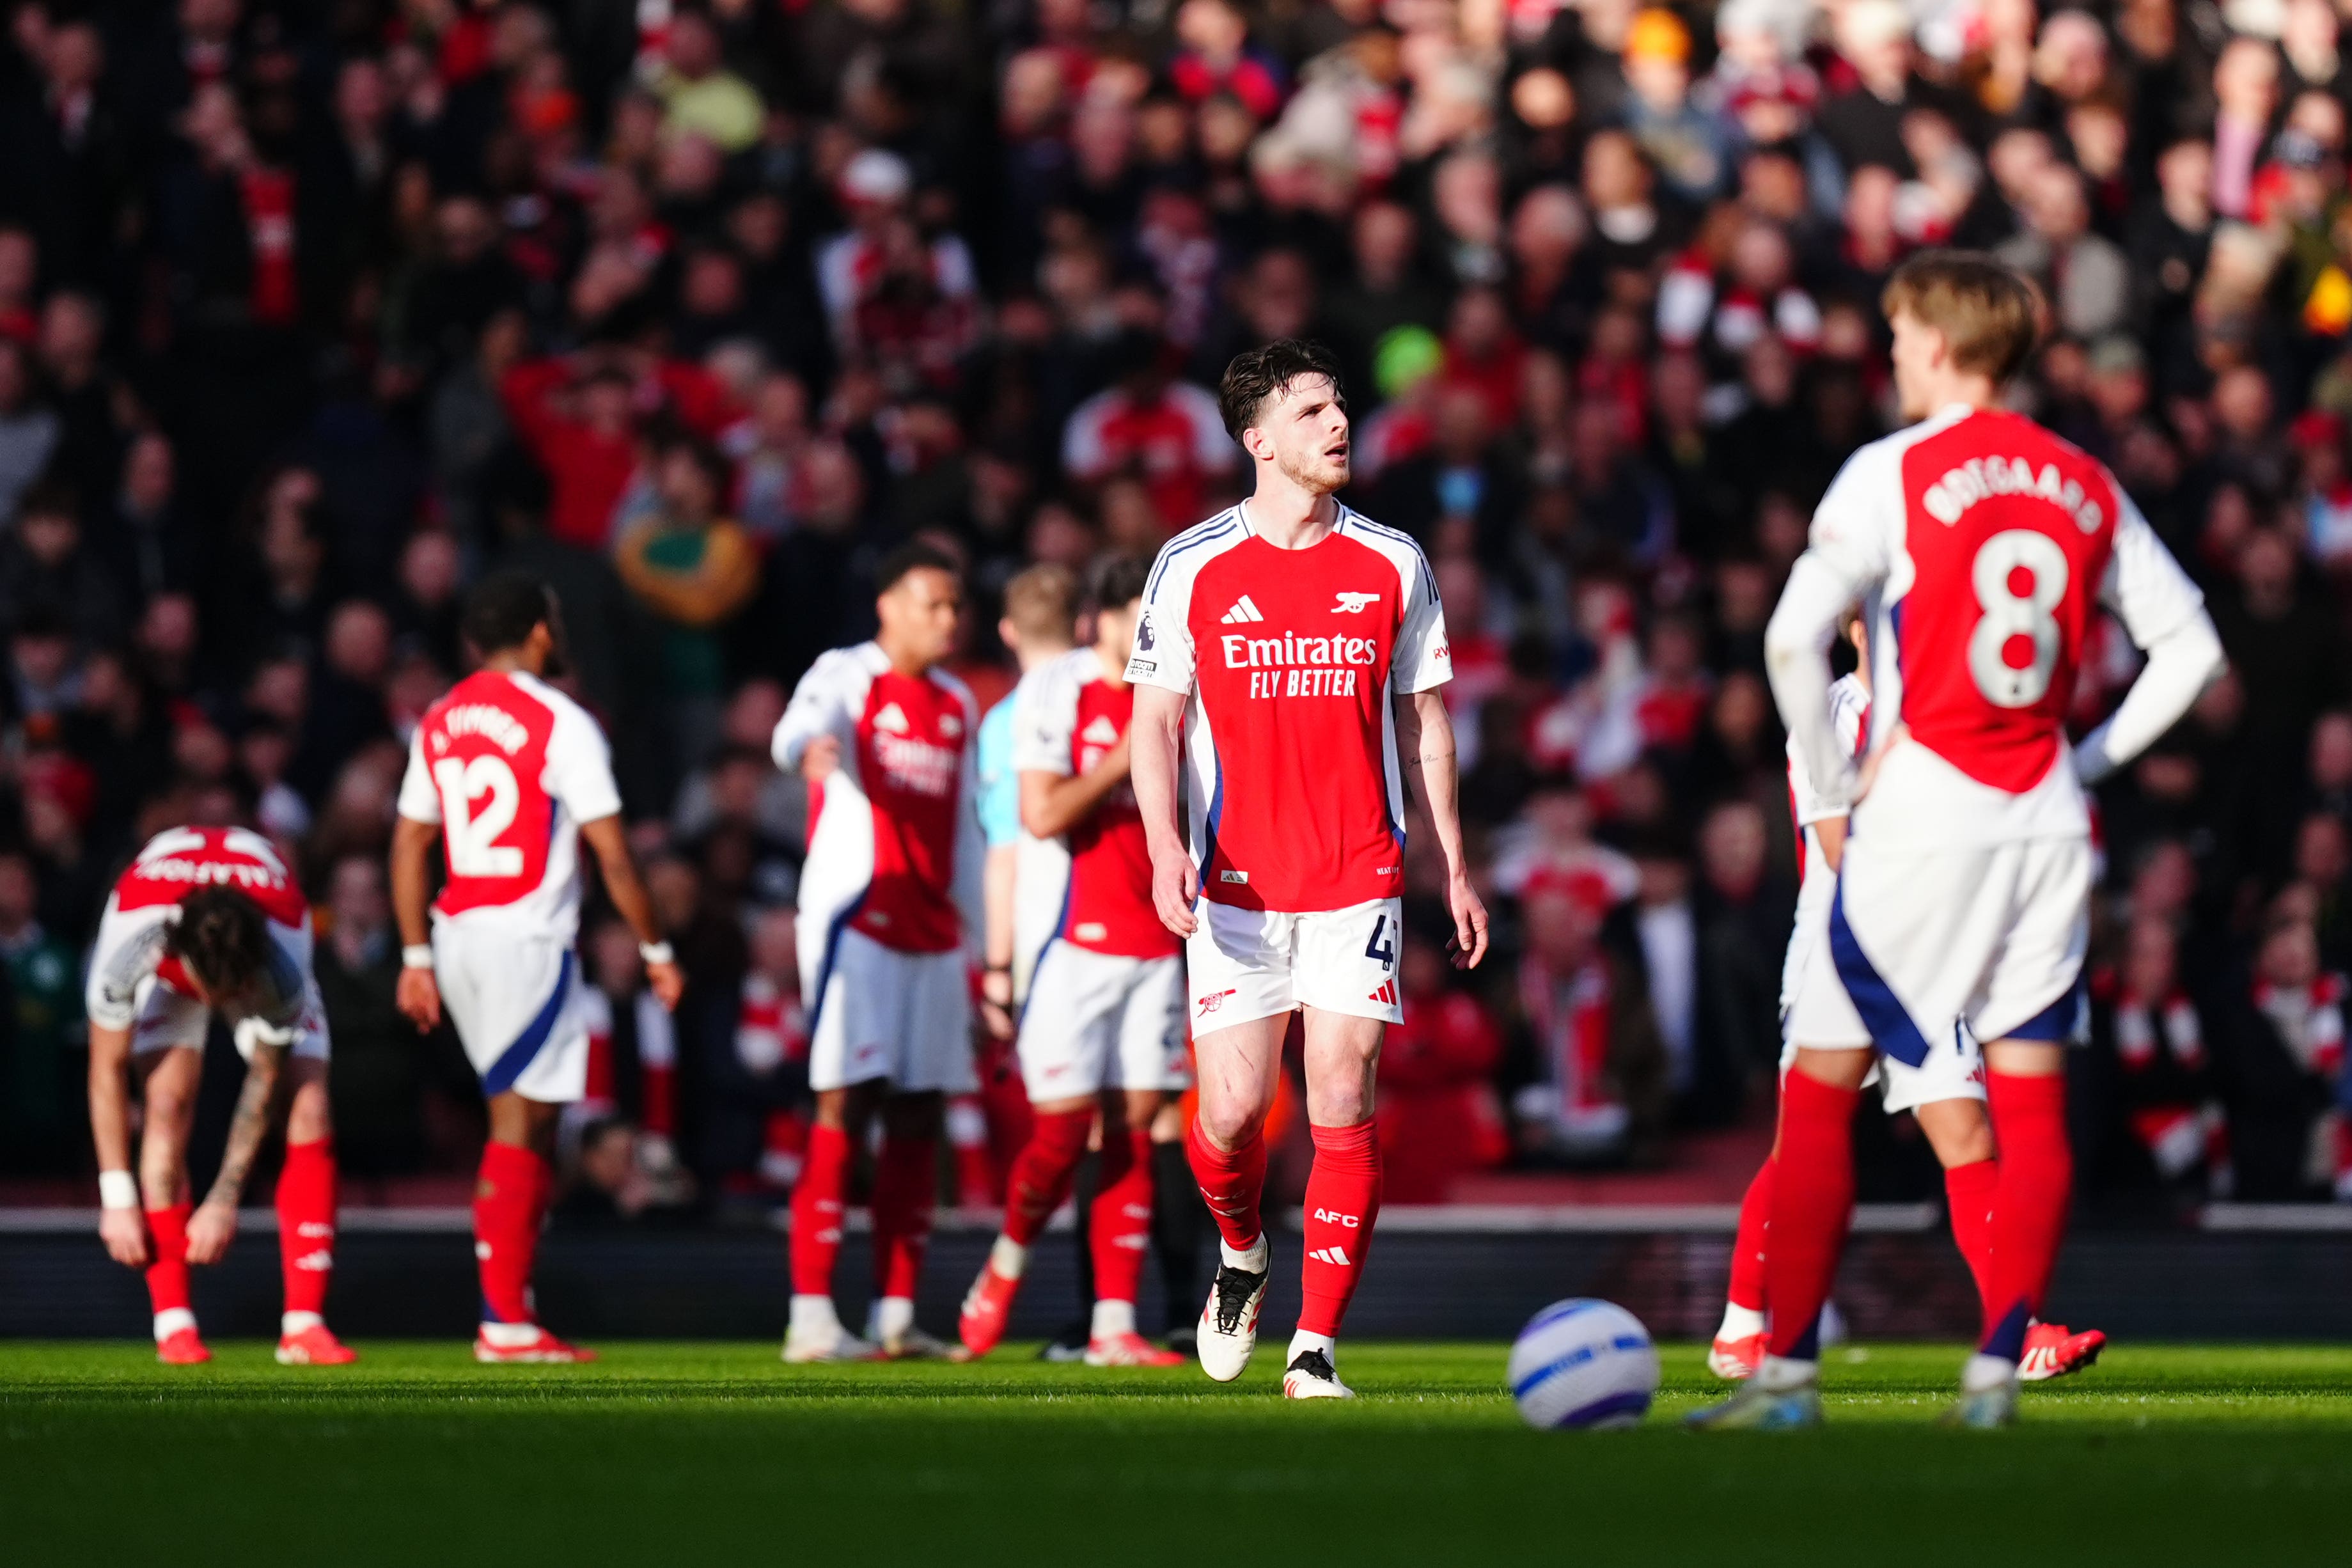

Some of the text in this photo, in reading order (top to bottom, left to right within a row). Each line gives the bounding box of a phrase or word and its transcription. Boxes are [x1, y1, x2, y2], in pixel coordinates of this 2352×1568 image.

[1966, 529, 2069, 708] 8
[1221, 630, 1376, 668] Emirates
[1250, 669, 1356, 699] FLY BETTER
[433, 755, 524, 877] 12
[1314, 1207, 1360, 1228] AFC
